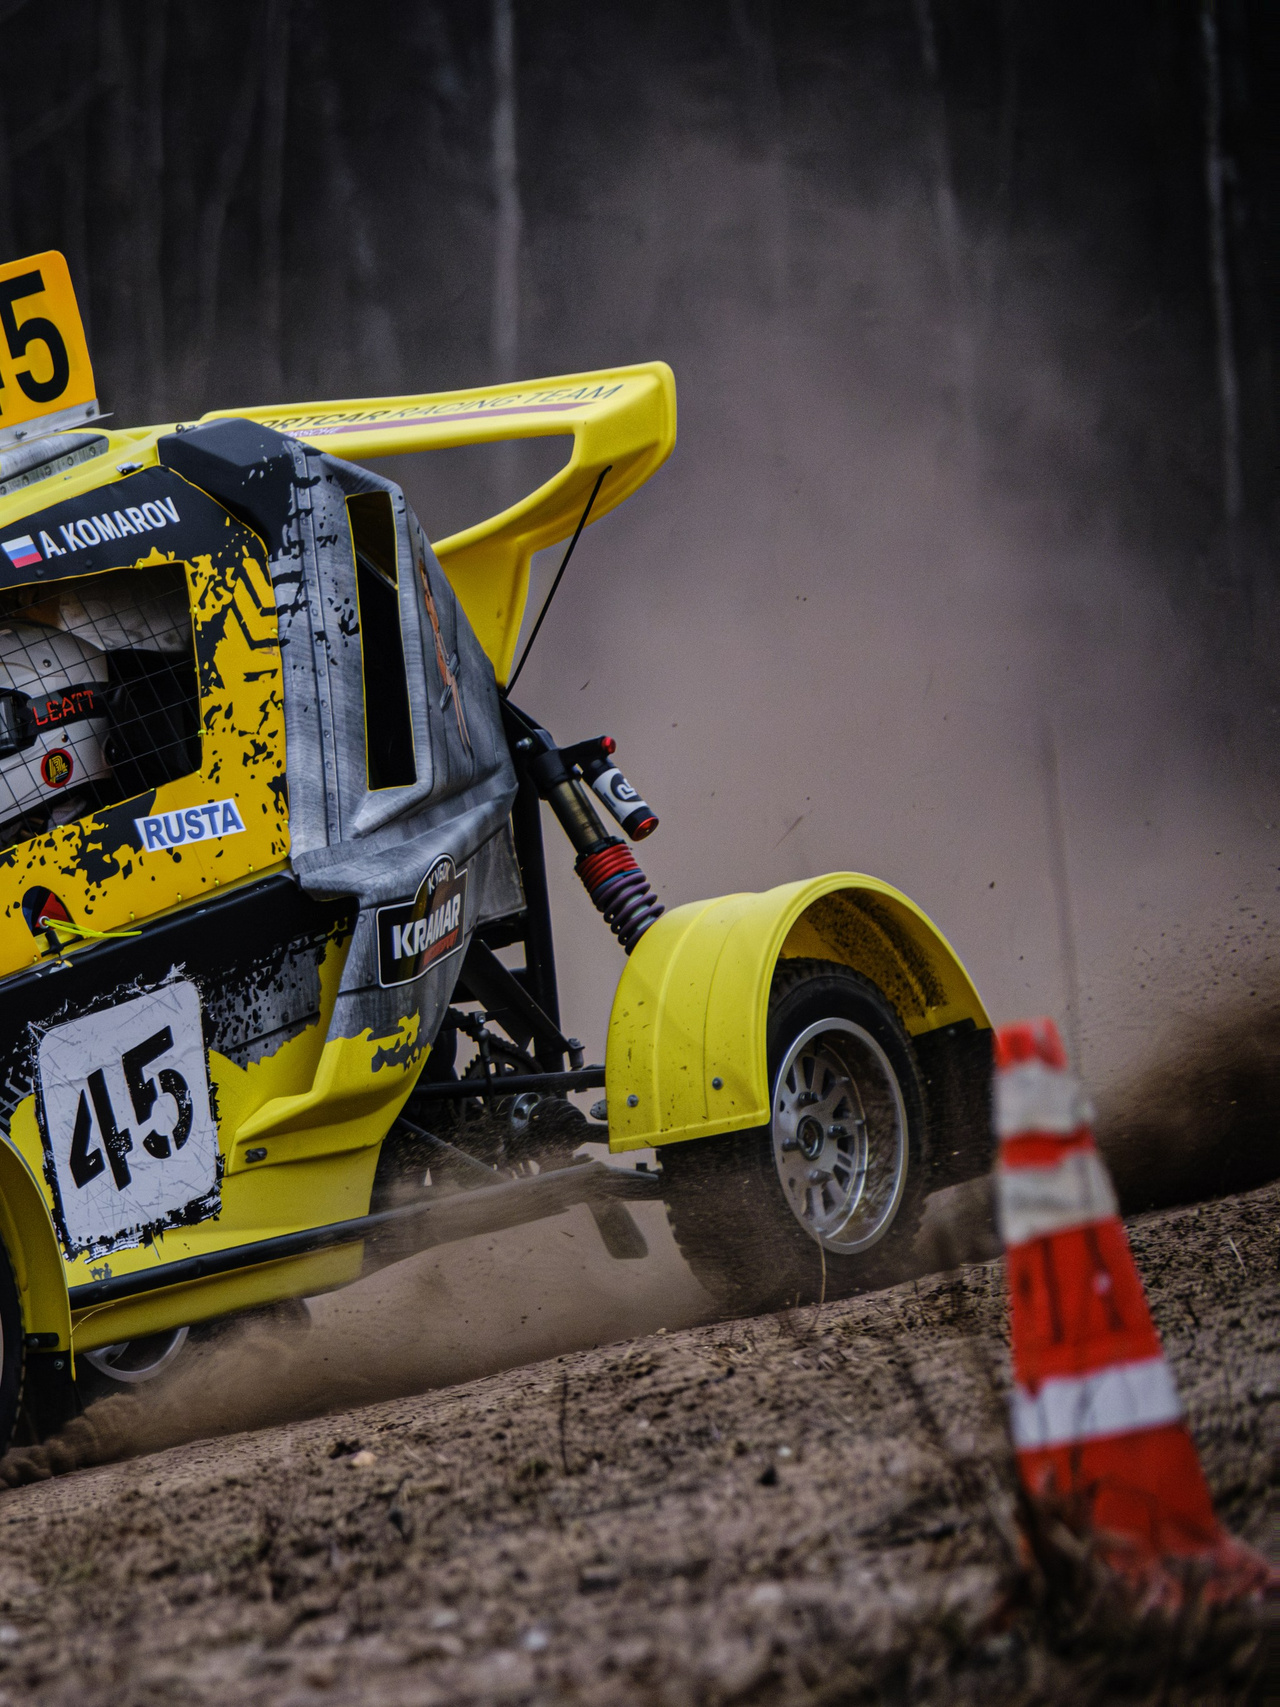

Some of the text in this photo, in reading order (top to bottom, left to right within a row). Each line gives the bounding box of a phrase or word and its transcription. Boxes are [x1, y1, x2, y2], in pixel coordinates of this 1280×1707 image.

[260, 384, 624, 430] ORTCAR RACING TEAM
[32, 690, 94, 726] LEATT
[143, 802, 243, 849] RUSTA
[393, 893, 461, 960] KRAMAR
[70, 1025, 194, 1191] 45
